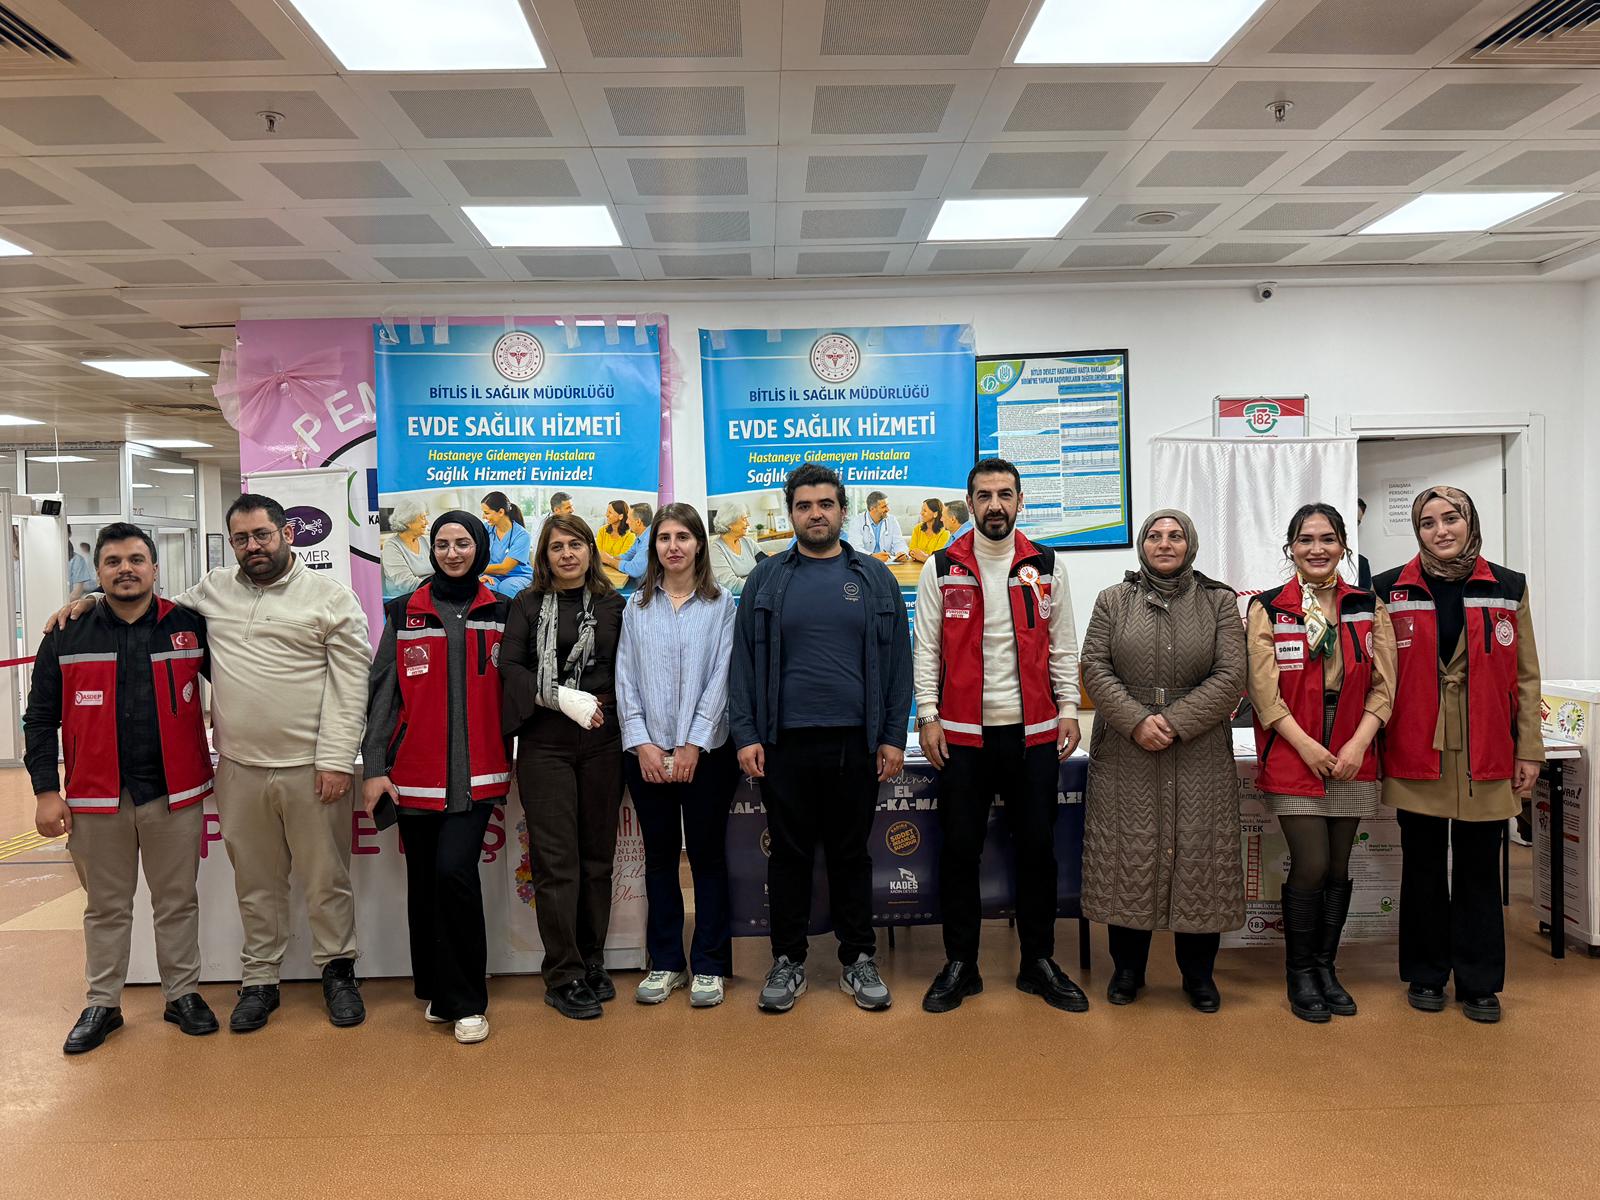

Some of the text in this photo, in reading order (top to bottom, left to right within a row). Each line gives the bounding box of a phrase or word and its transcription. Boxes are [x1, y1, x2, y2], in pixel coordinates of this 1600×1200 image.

[429, 384, 615, 399] BİTLİS İL SAĞLIK MÜDÜRLÜĞÜ
[749, 384, 929, 402] BİTLİS İL SAĞLIK MÜDÜRLÜĞÜ
[407, 411, 621, 436] EVDE SAĞLIK HİZMETİ
[728, 411, 936, 440] EVDE SAĞLIK HİZMETİ
[1252, 413, 1271, 425] 182
[428, 449, 596, 463] Hastaneye Gidemeyen Hastalara
[748, 449, 910, 465] Hastaneye Gidemeyen Hastalara
[426, 466, 593, 485] Sağlık Hizmeti Evinizde!
[747, 469, 787, 486] Sağlık
[847, 466, 909, 481] Evinizde!
[894, 785, 914, 798] EL
[889, 880, 919, 890] KADES
[1250, 921, 1264, 929] 183
